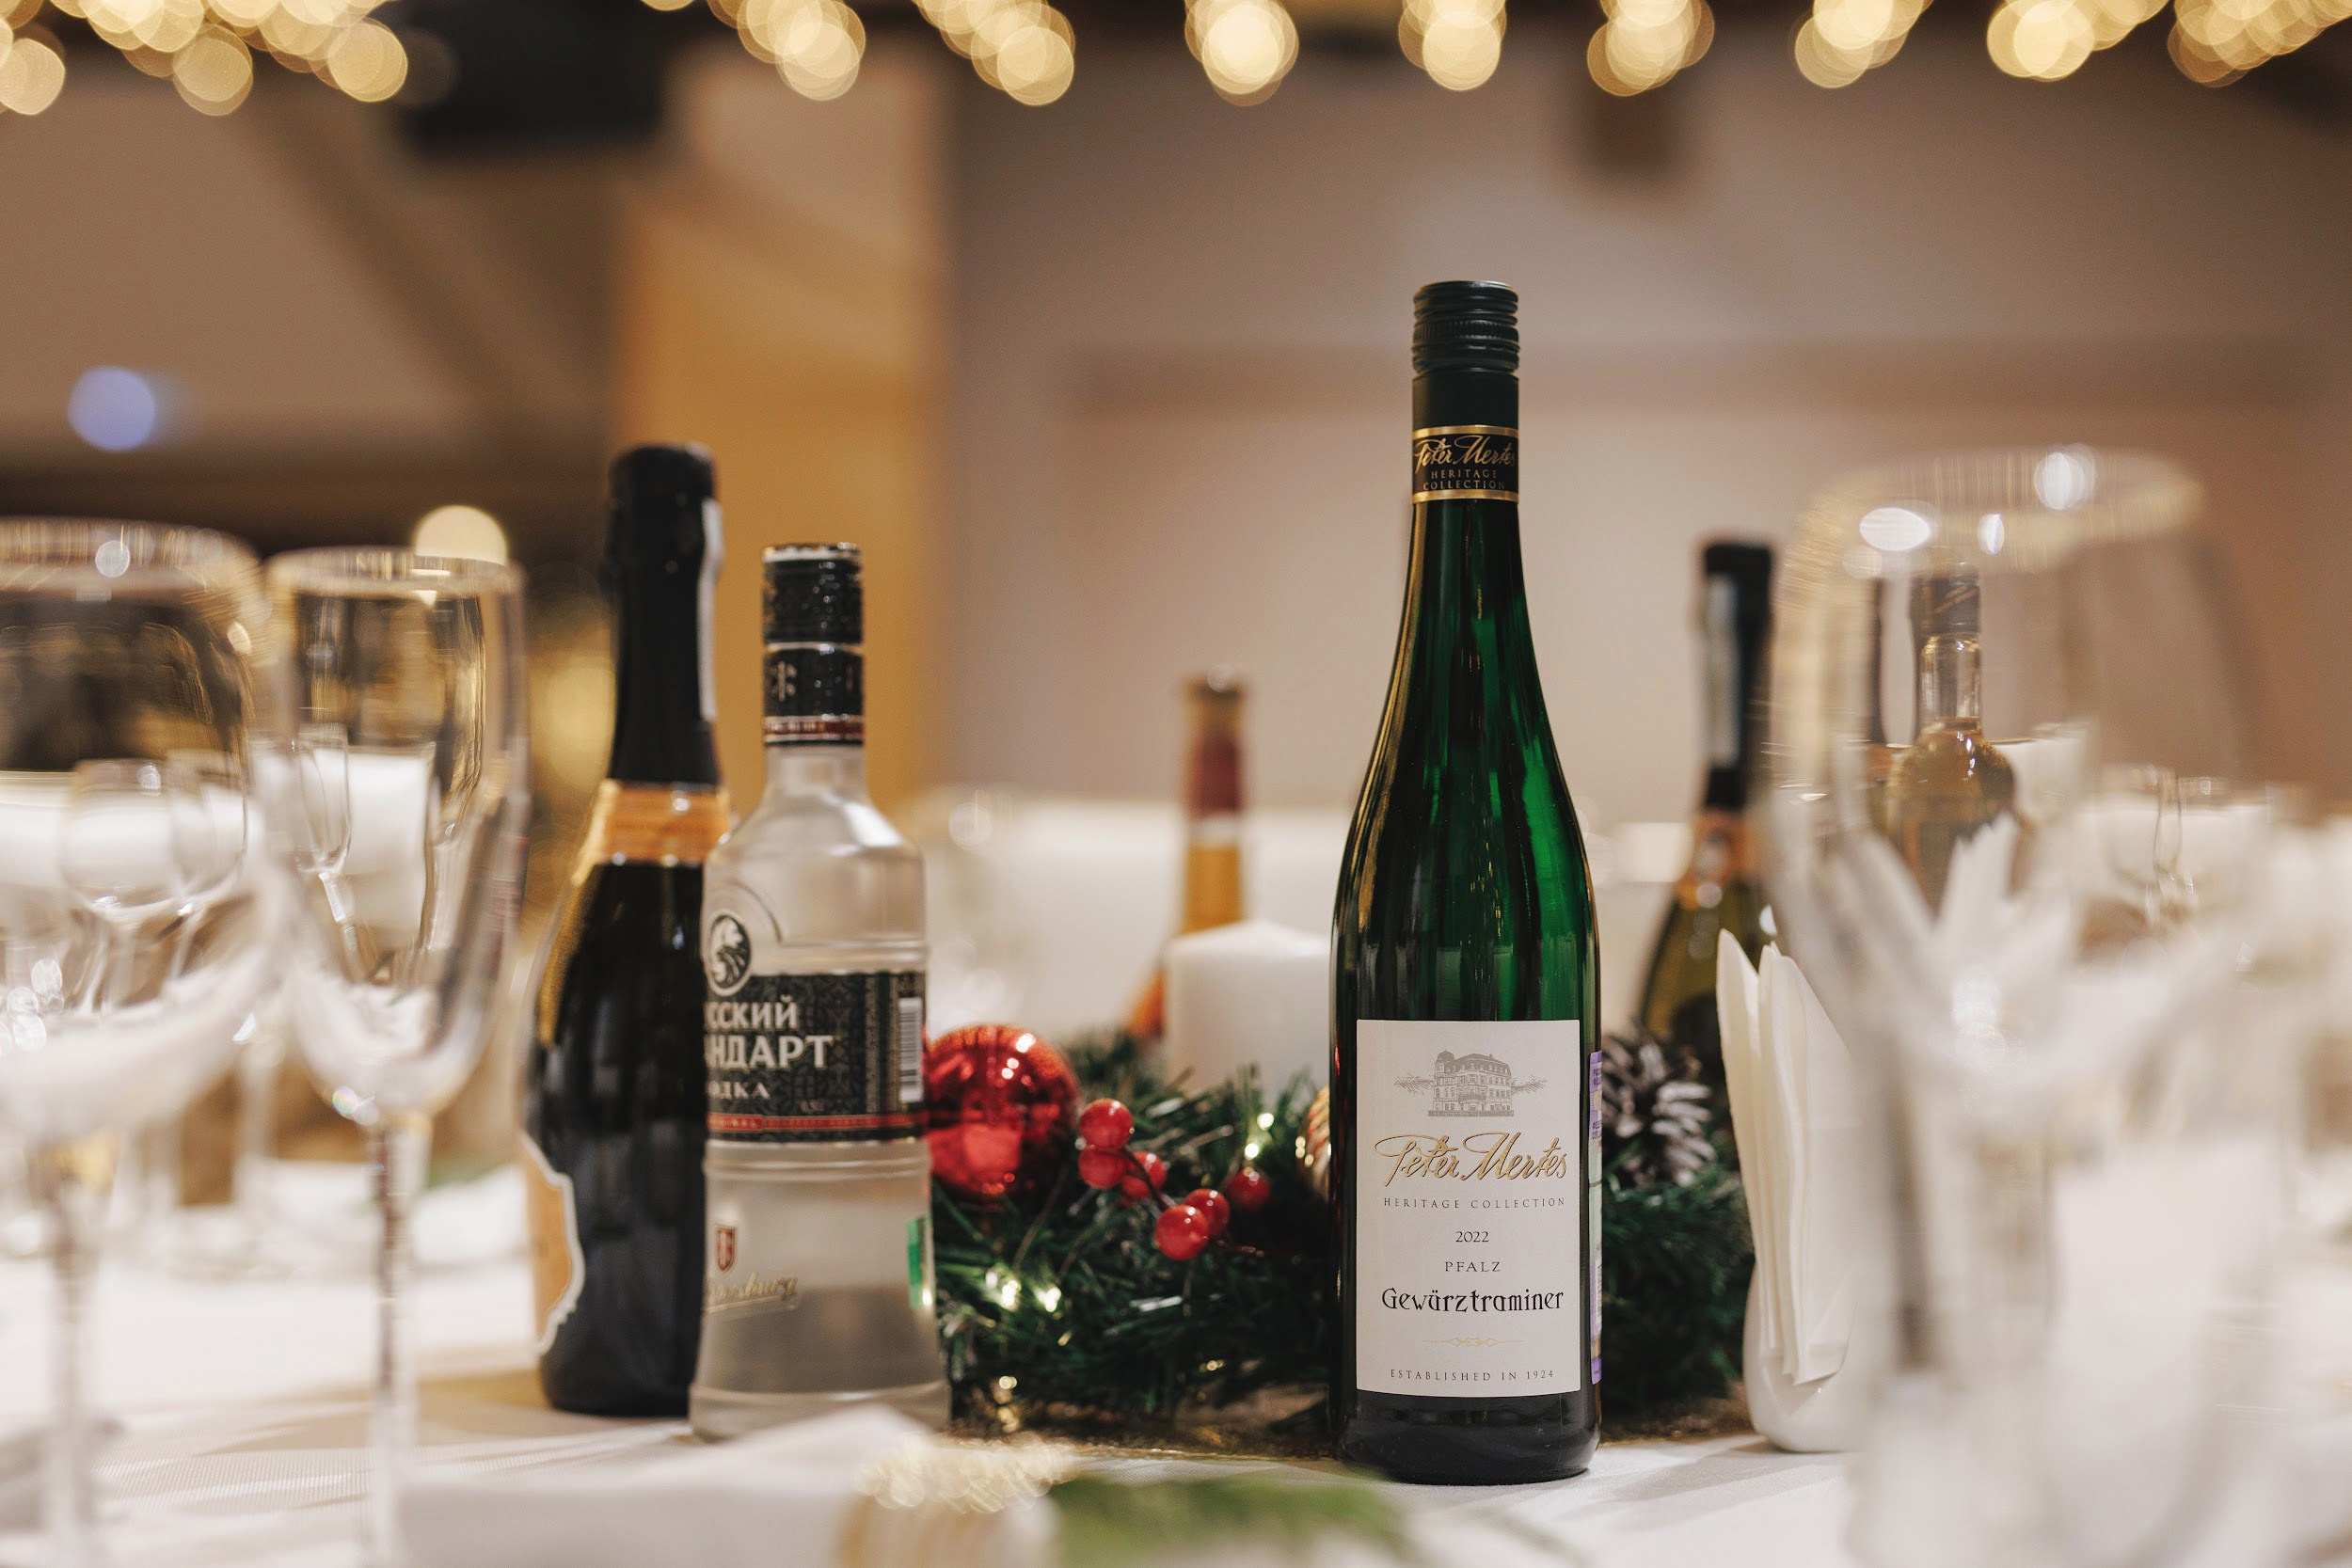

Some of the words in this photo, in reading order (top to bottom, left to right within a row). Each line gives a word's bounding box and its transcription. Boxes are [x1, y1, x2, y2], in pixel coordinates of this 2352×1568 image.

[1415, 438, 1452, 475] Peter
[1431, 469, 1498, 480] HERITAGE
[1422, 480, 1505, 490] COLLECTION
[705, 994, 798, 1030] ССКИЙ
[707, 1081, 771, 1100] ОДКА
[1375, 1134, 1459, 1187] Peter
[1460, 1132, 1567, 1180] Mertes
[1384, 1197, 1459, 1209] HERITAGE
[1470, 1196, 1565, 1210] COLLECTION
[1455, 1230, 1489, 1243] 2022
[1445, 1261, 1501, 1272] PFALZ
[1381, 1287, 1564, 1313] Gewürztraminer
[1391, 1370, 1491, 1381] ESTABLISHED
[1502, 1371, 1517, 1381] IN
[1526, 1370, 1553, 1380] 1924
